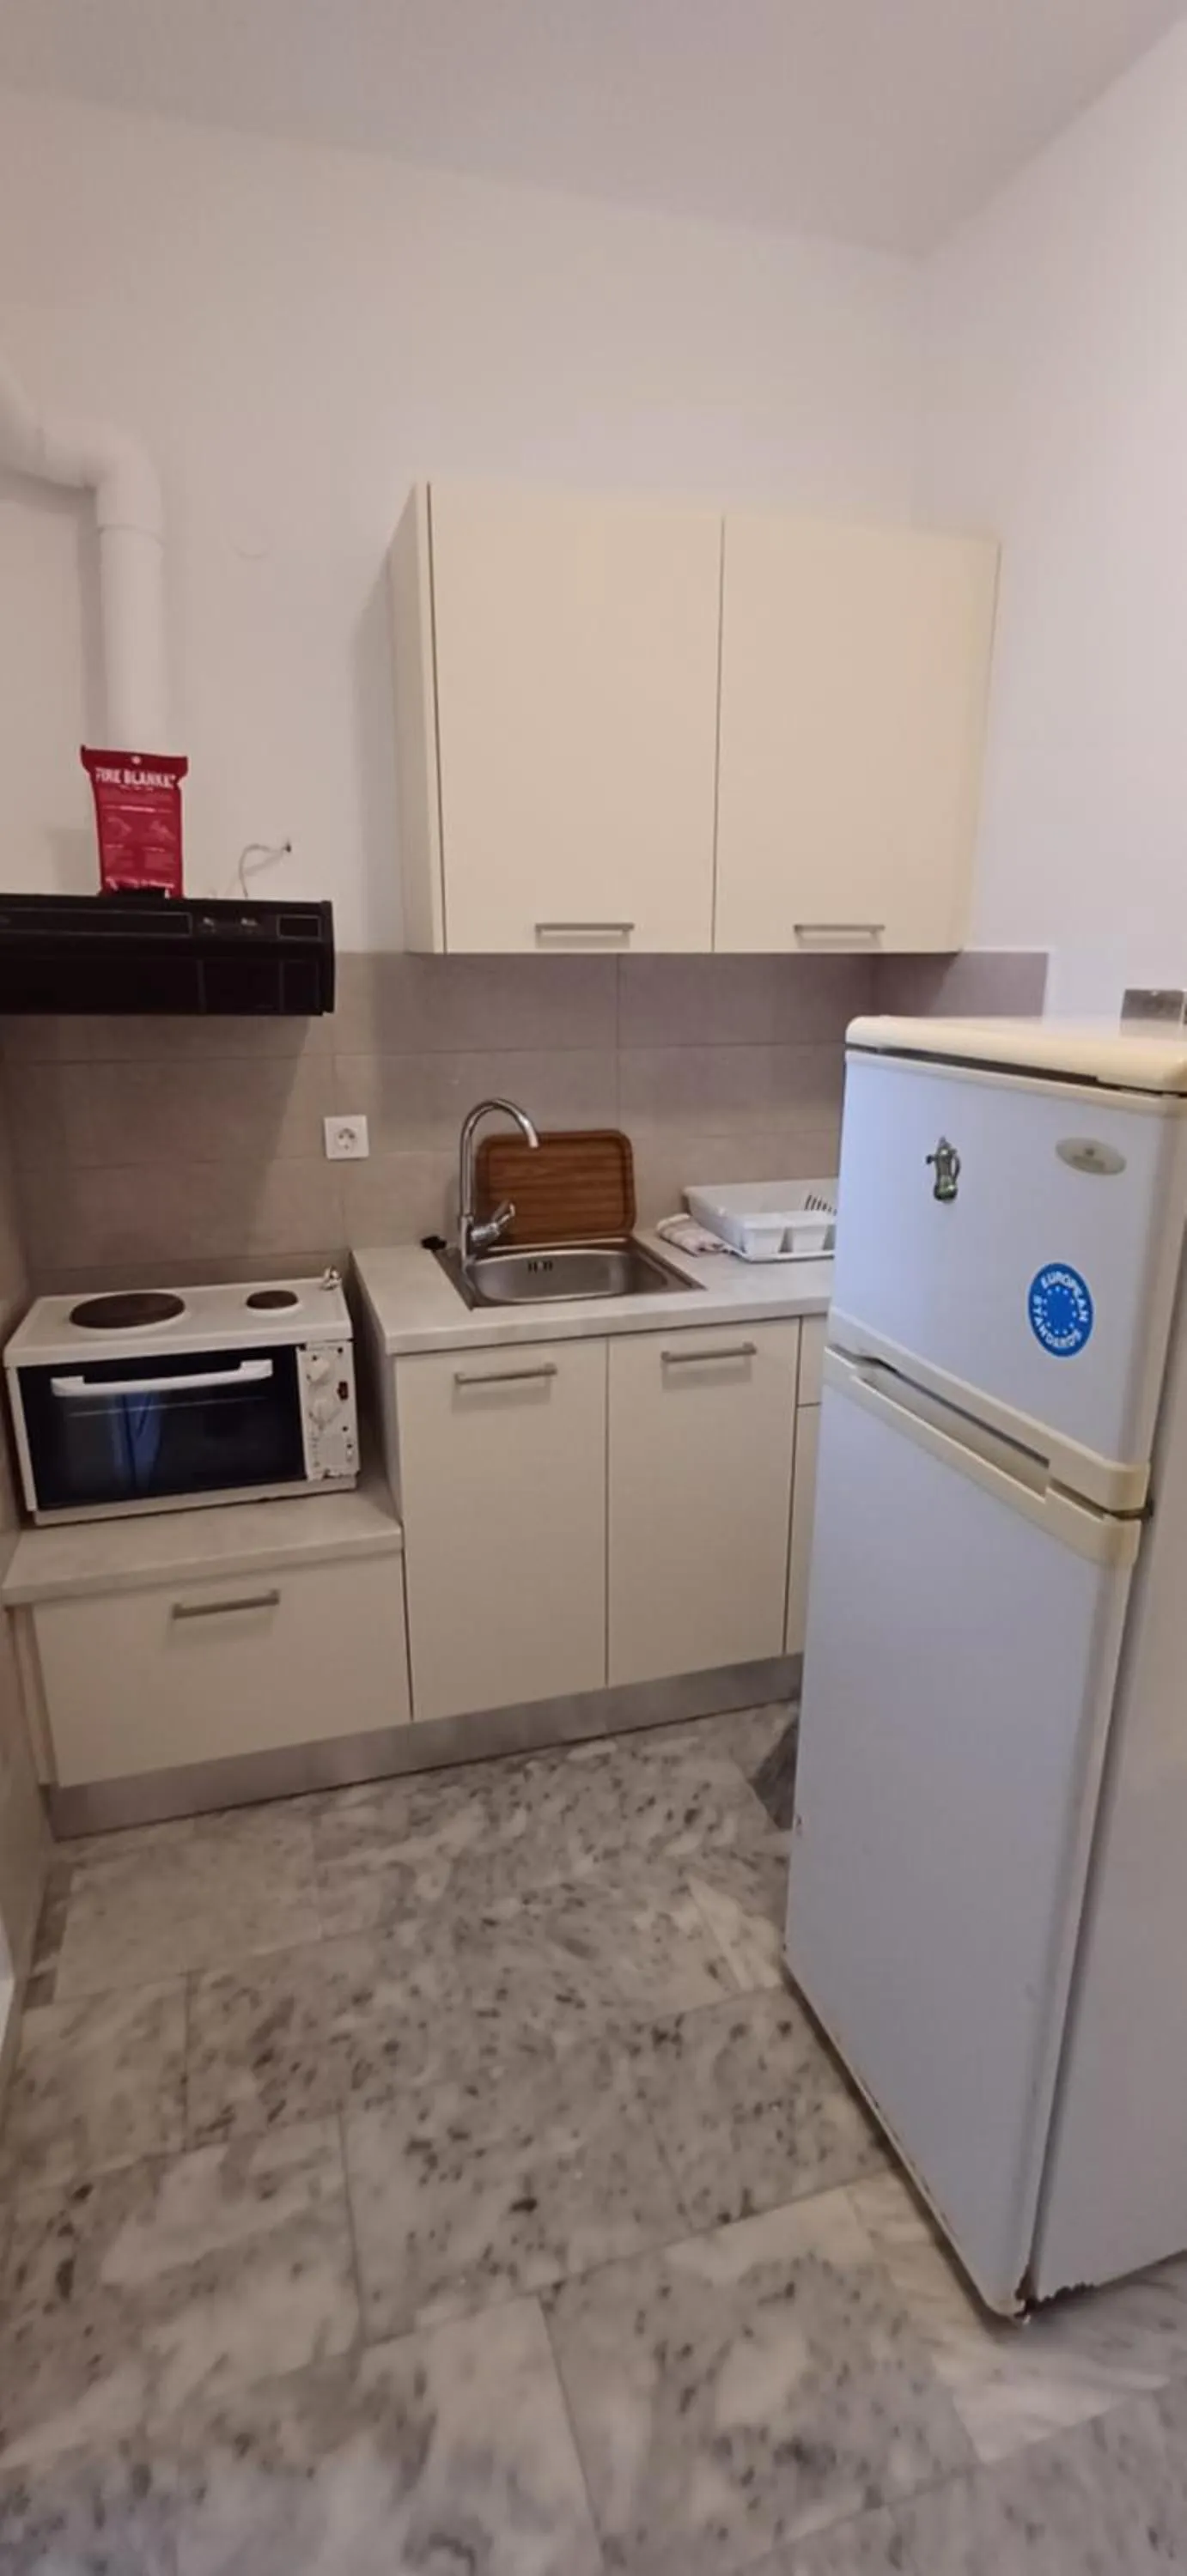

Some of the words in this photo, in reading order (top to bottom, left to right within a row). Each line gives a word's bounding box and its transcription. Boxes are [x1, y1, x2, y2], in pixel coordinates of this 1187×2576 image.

[95, 768, 121, 783] FIRE
[1033, 1295, 1082, 1347] STANDARDS
[1040, 1271, 1087, 1322] EUROPEAN
